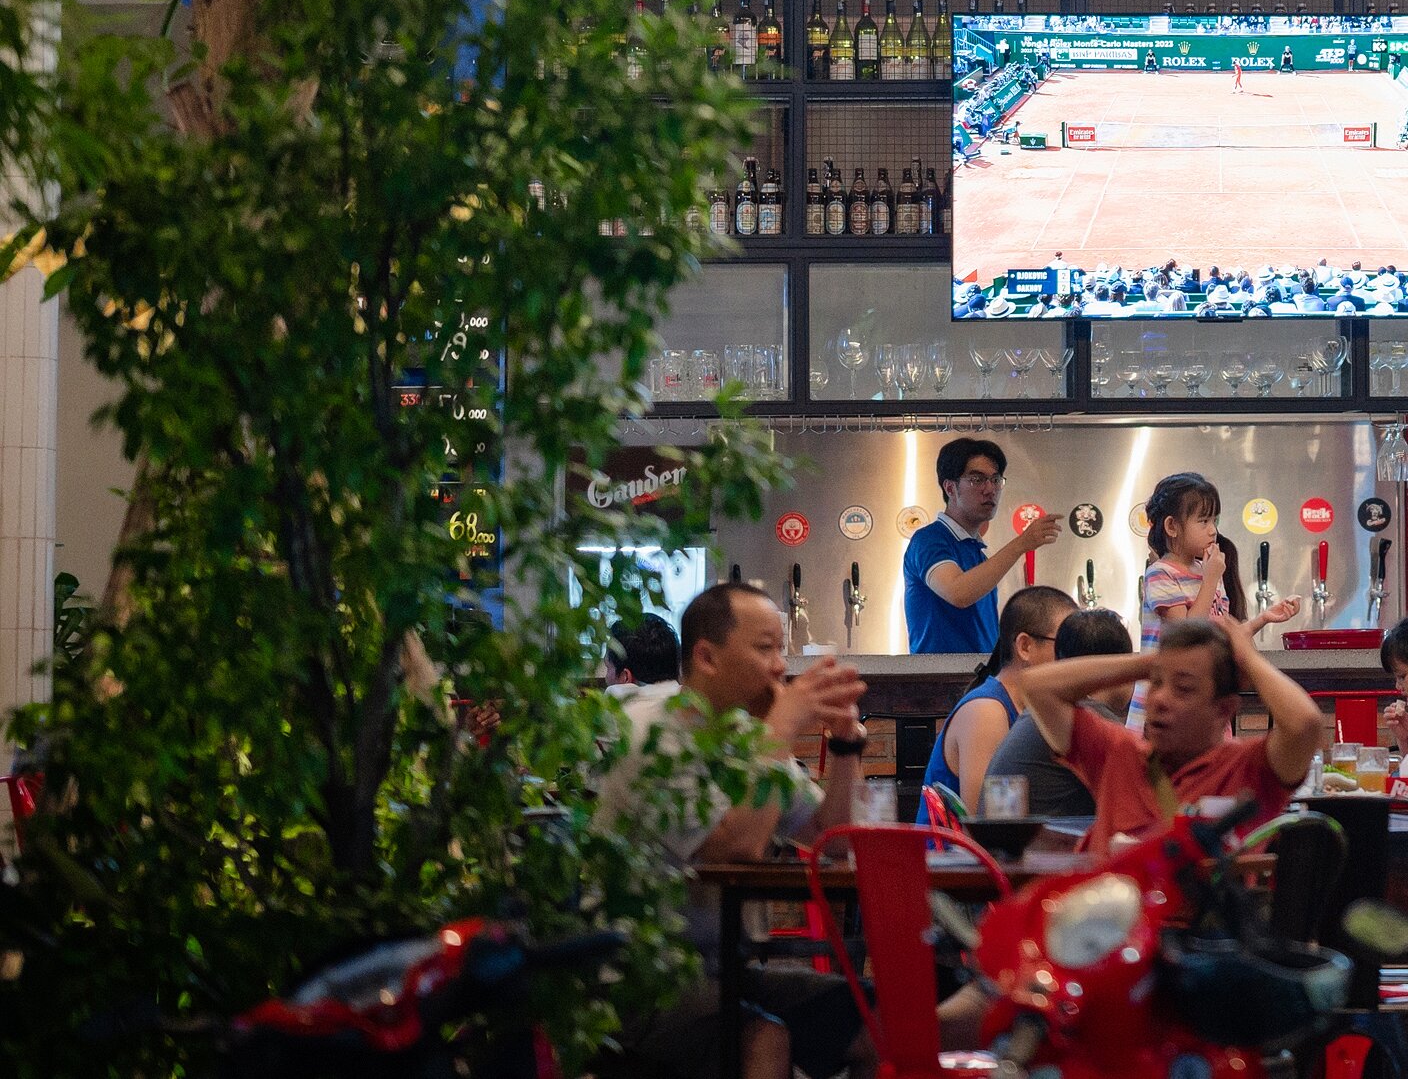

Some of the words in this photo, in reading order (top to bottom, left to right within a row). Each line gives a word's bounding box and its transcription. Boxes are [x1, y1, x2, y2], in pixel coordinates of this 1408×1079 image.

[1123, 40, 1153, 48] Masters
[1162, 57, 1206, 67] ROLEX
[1231, 57, 1275, 67] ROLEX
[1016, 271, 1048, 280] DJOKOVIC
